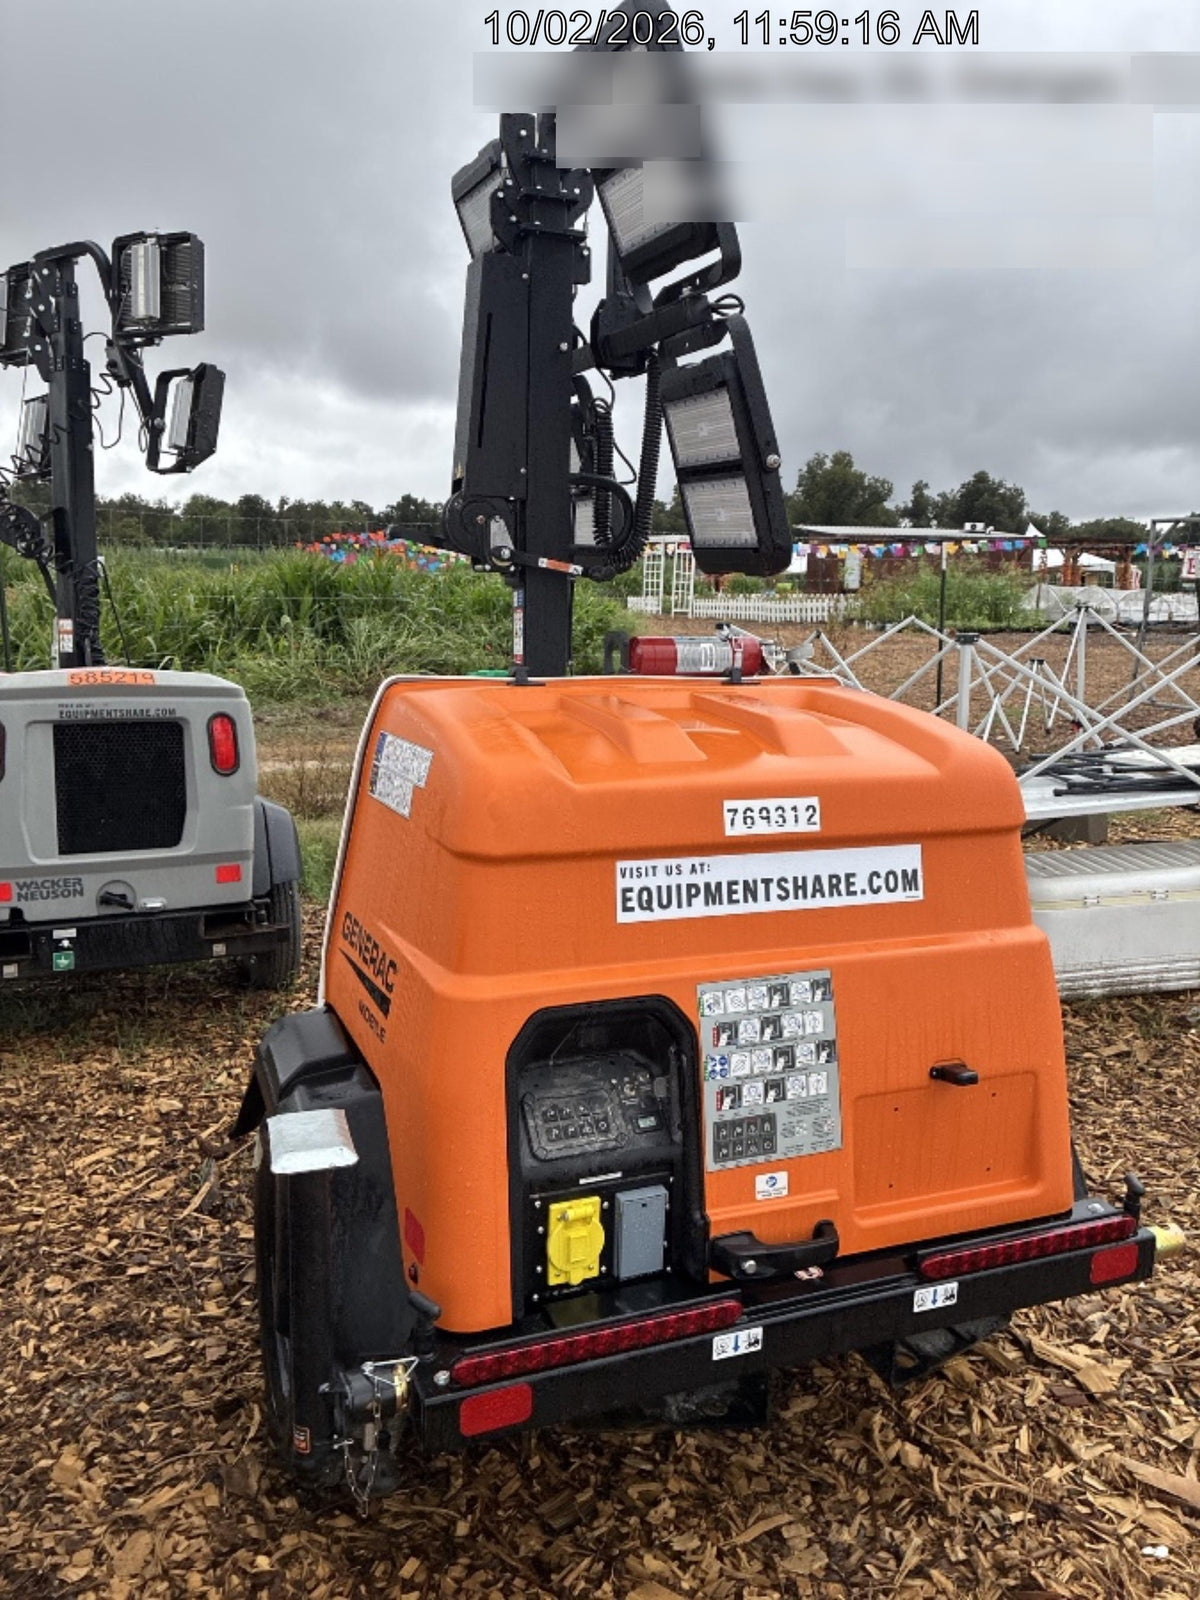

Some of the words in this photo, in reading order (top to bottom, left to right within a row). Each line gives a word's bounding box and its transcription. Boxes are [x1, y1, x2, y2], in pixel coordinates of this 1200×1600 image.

[70, 671, 155, 685] 585219
[726, 803, 818, 830] 769312
[620, 864, 658, 879] VISIT
[665, 863, 683, 877] US
[689, 862, 711, 875] AT:
[15, 877, 83, 892] WACKER
[621, 868, 920, 912] EQUIPMENTSHARE.COM
[16, 887, 84, 903] NEUSON
[341, 911, 398, 994] GENERAC
